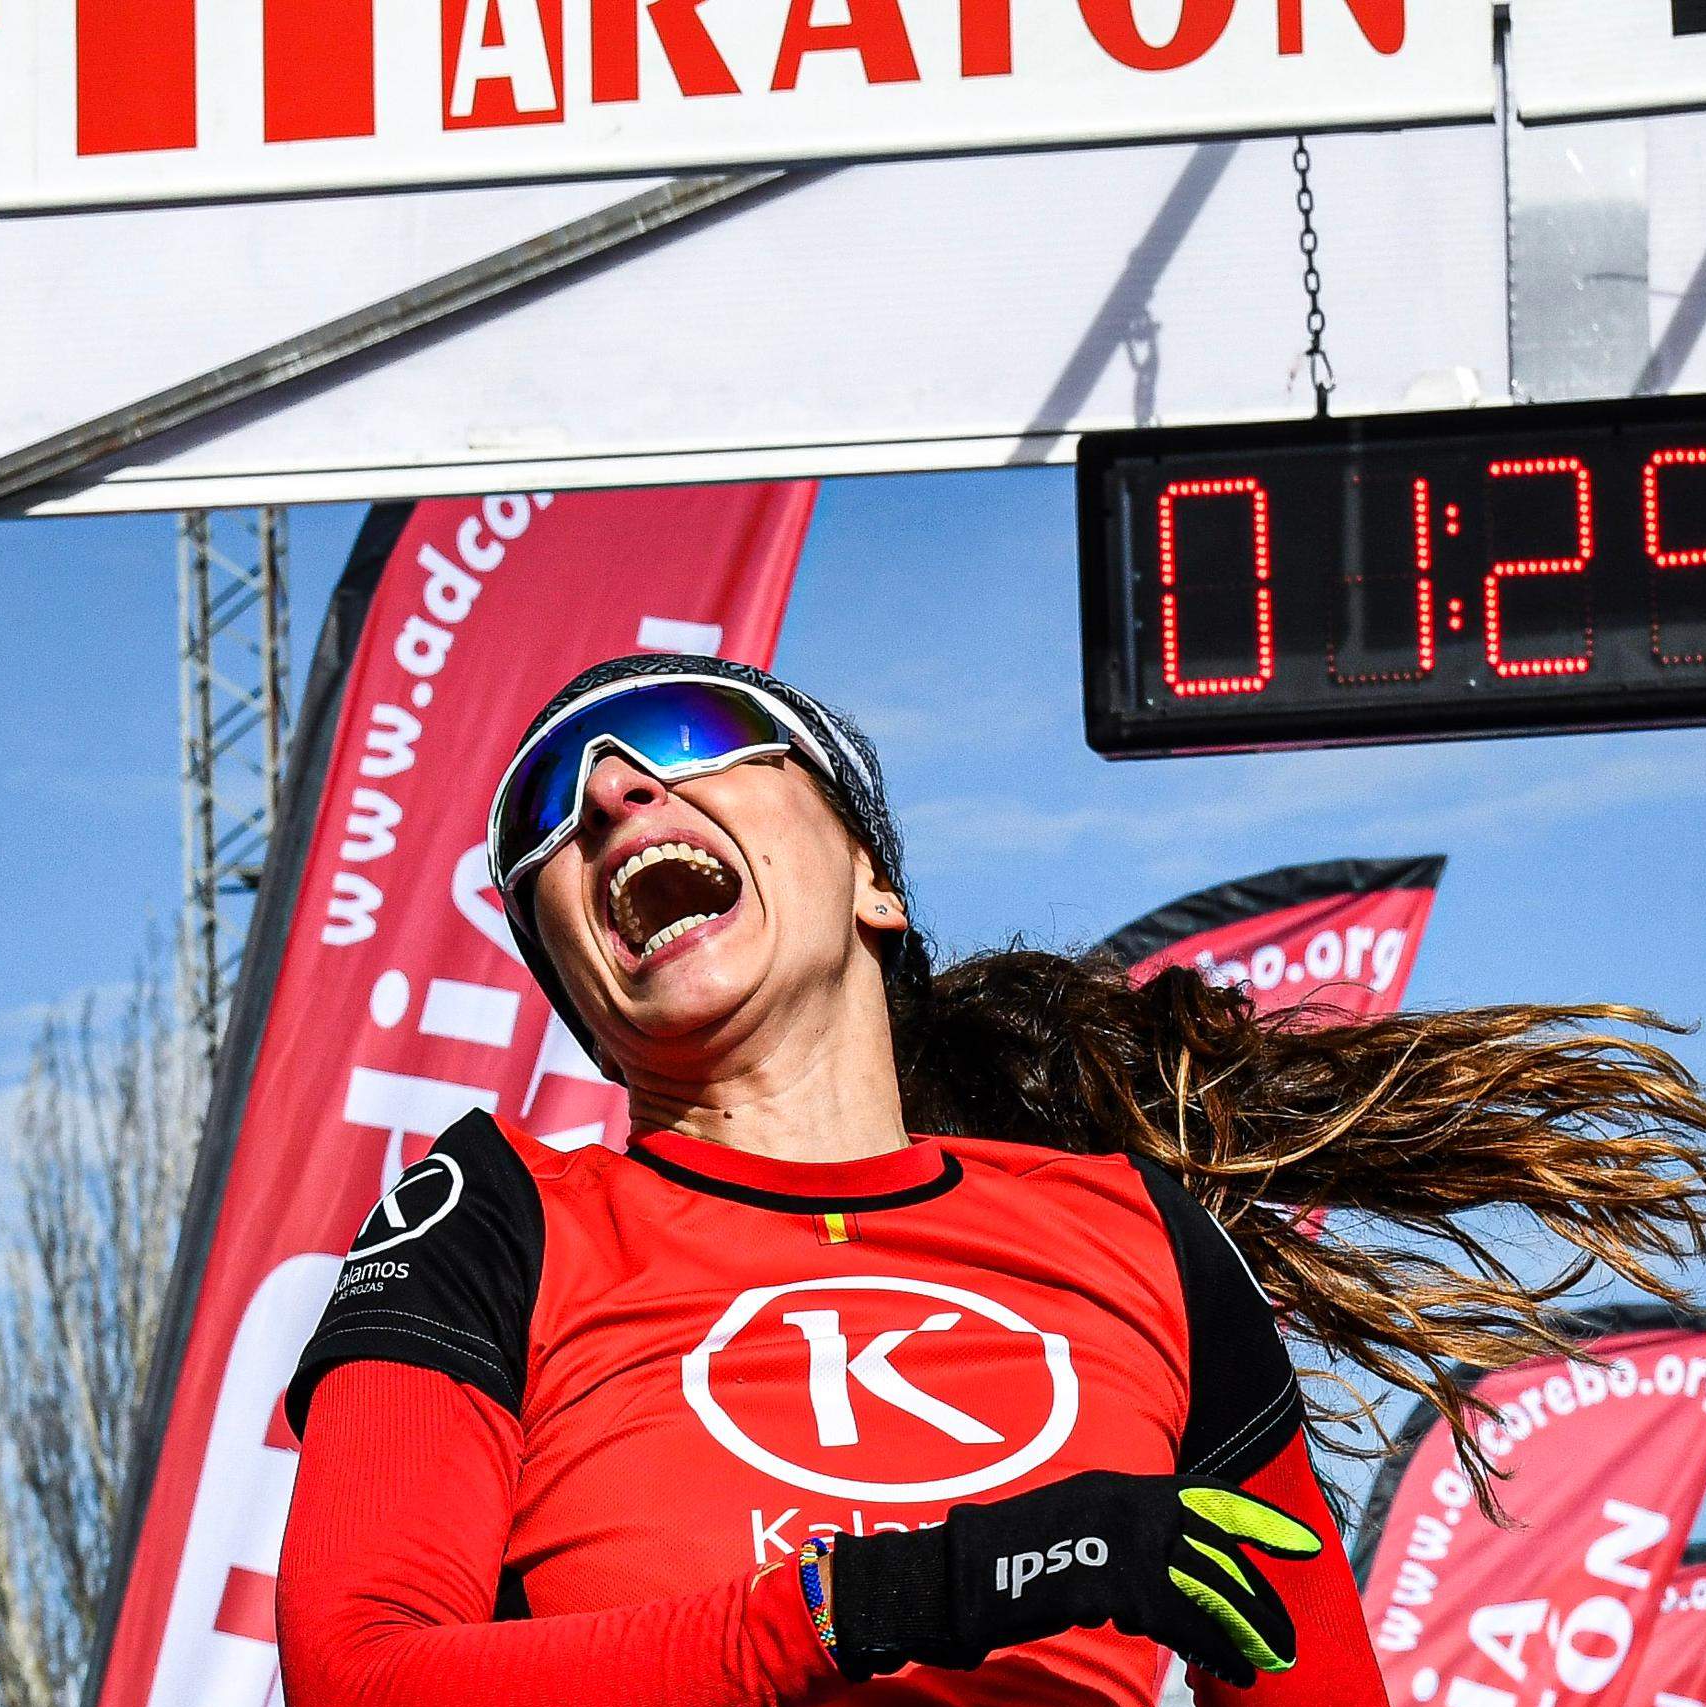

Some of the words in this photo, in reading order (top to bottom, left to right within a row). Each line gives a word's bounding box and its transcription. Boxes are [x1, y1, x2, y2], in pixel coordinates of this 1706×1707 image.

[335, 1261, 410, 1293] alamos
[349, 1281, 384, 1297] ROZAS
[782, 1309, 1006, 1447] K
[751, 1508, 948, 1565] Kal
